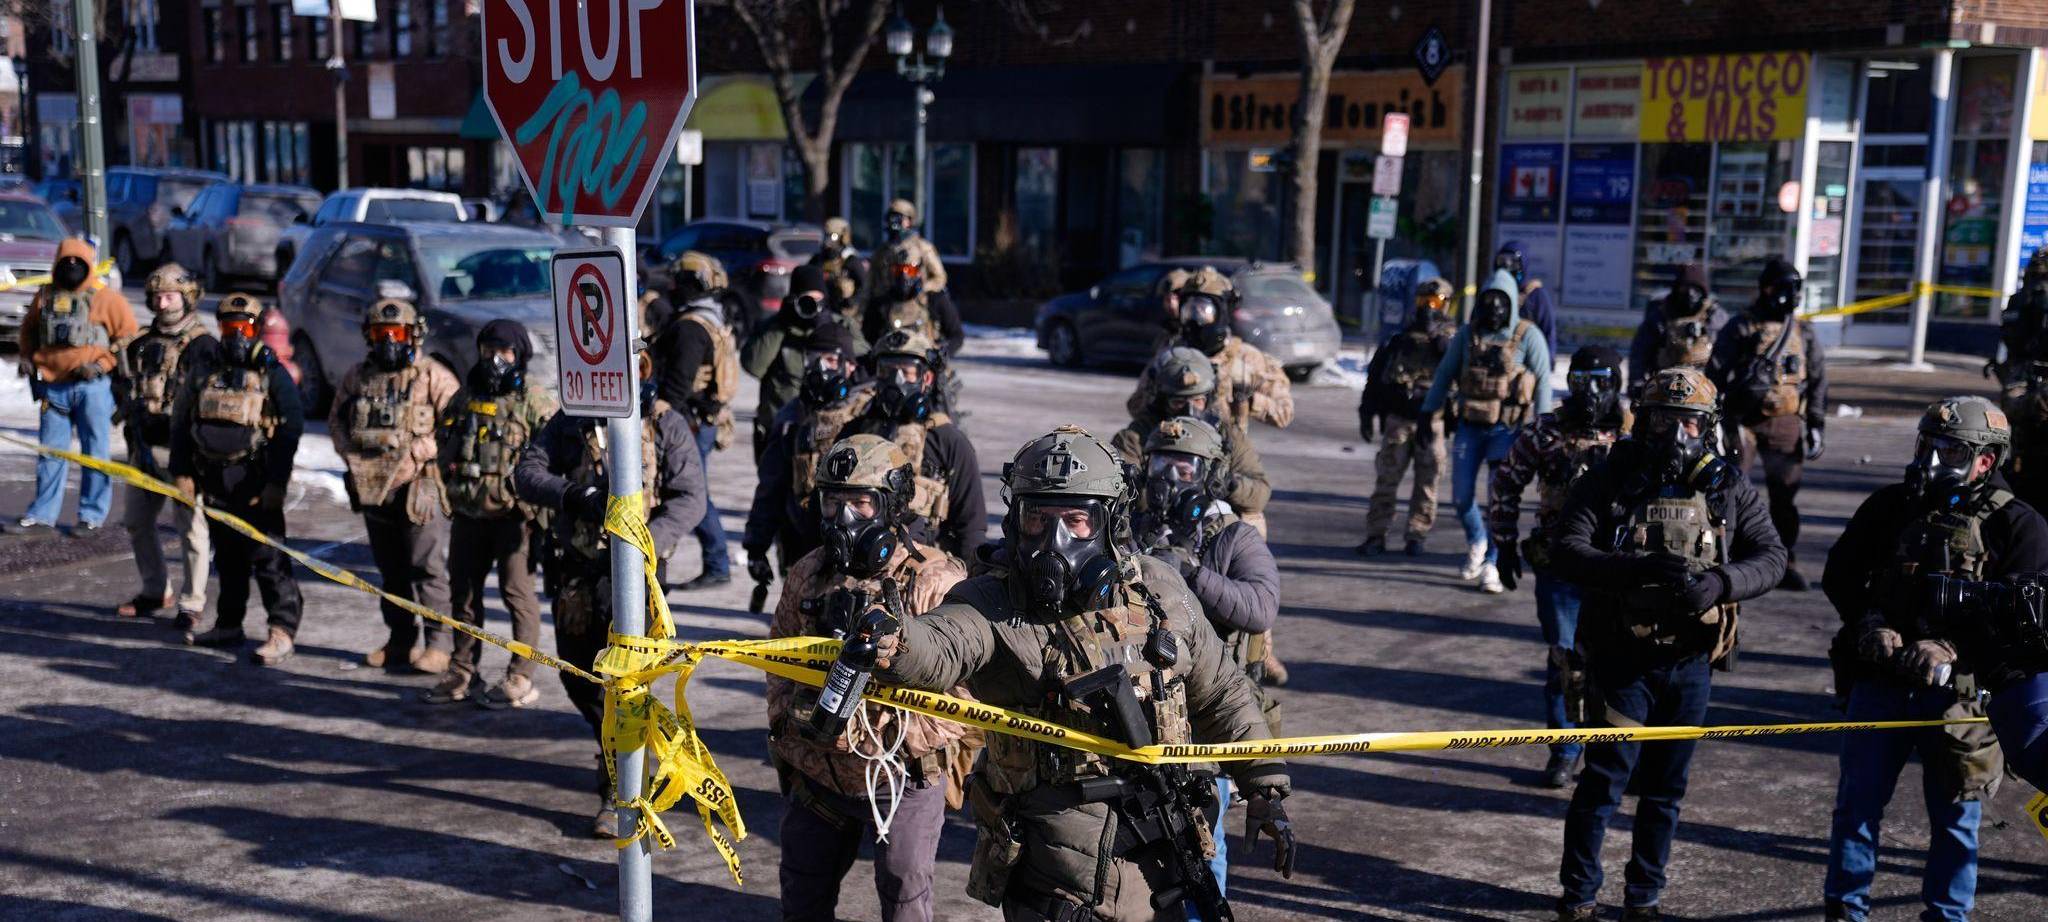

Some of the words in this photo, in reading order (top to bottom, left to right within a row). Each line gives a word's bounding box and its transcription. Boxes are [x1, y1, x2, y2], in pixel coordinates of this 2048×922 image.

[498, 0, 663, 83] STOP
[1646, 51, 1805, 100] TOBACCO
[1665, 101, 1687, 142] &
[1705, 94, 1777, 142] MAS
[566, 371, 584, 400] 30
[591, 371, 624, 401] FEET
[1650, 508, 1697, 520] POLIC
[889, 688, 931, 709] LINE
[935, 699, 960, 714] DO
[964, 706, 1004, 723] NOT
